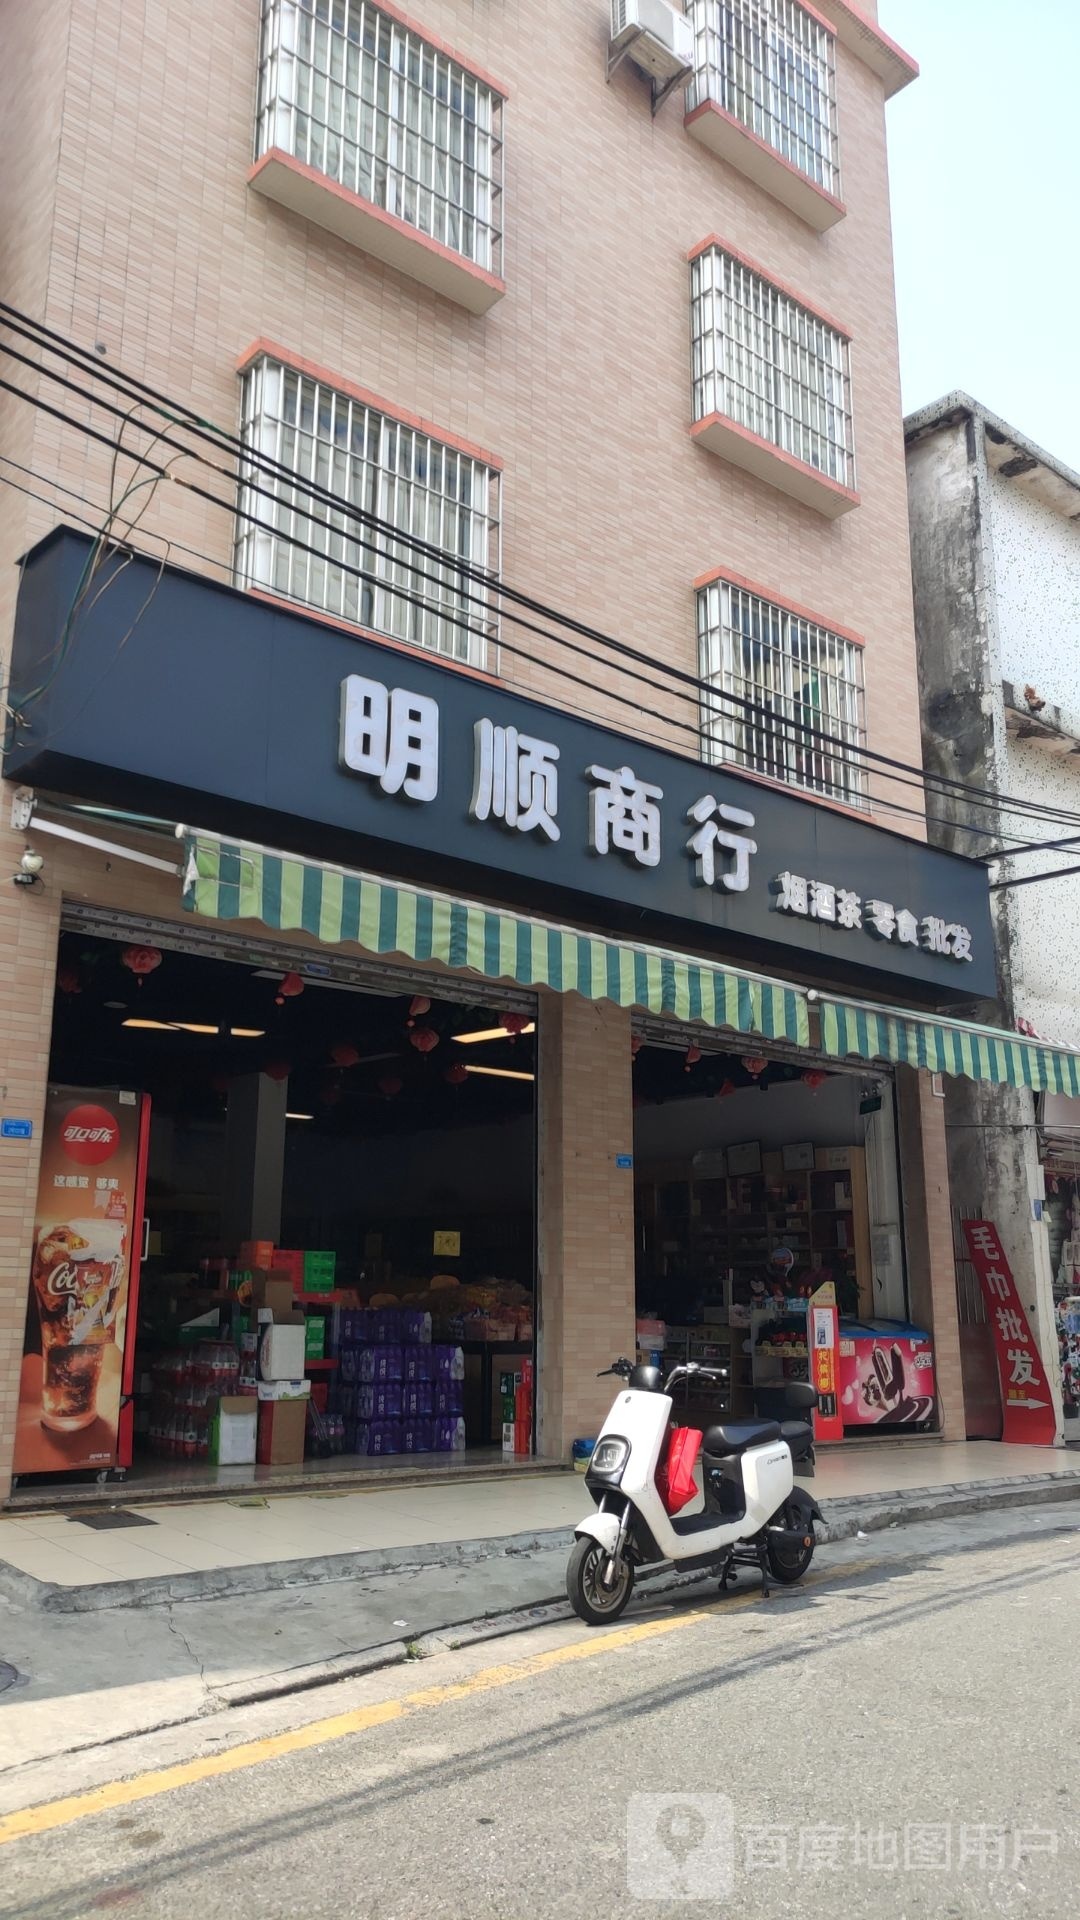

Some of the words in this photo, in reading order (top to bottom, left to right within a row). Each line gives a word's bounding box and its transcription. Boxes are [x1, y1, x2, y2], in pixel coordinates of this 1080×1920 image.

[339, 673, 757, 892] 明顺商行
[865, 899, 919, 946] 零食
[921, 915, 973, 962] 批发
[64, 1126, 116, 1143] 可口可乐
[971, 1226, 1040, 1386] 毛巾批发
